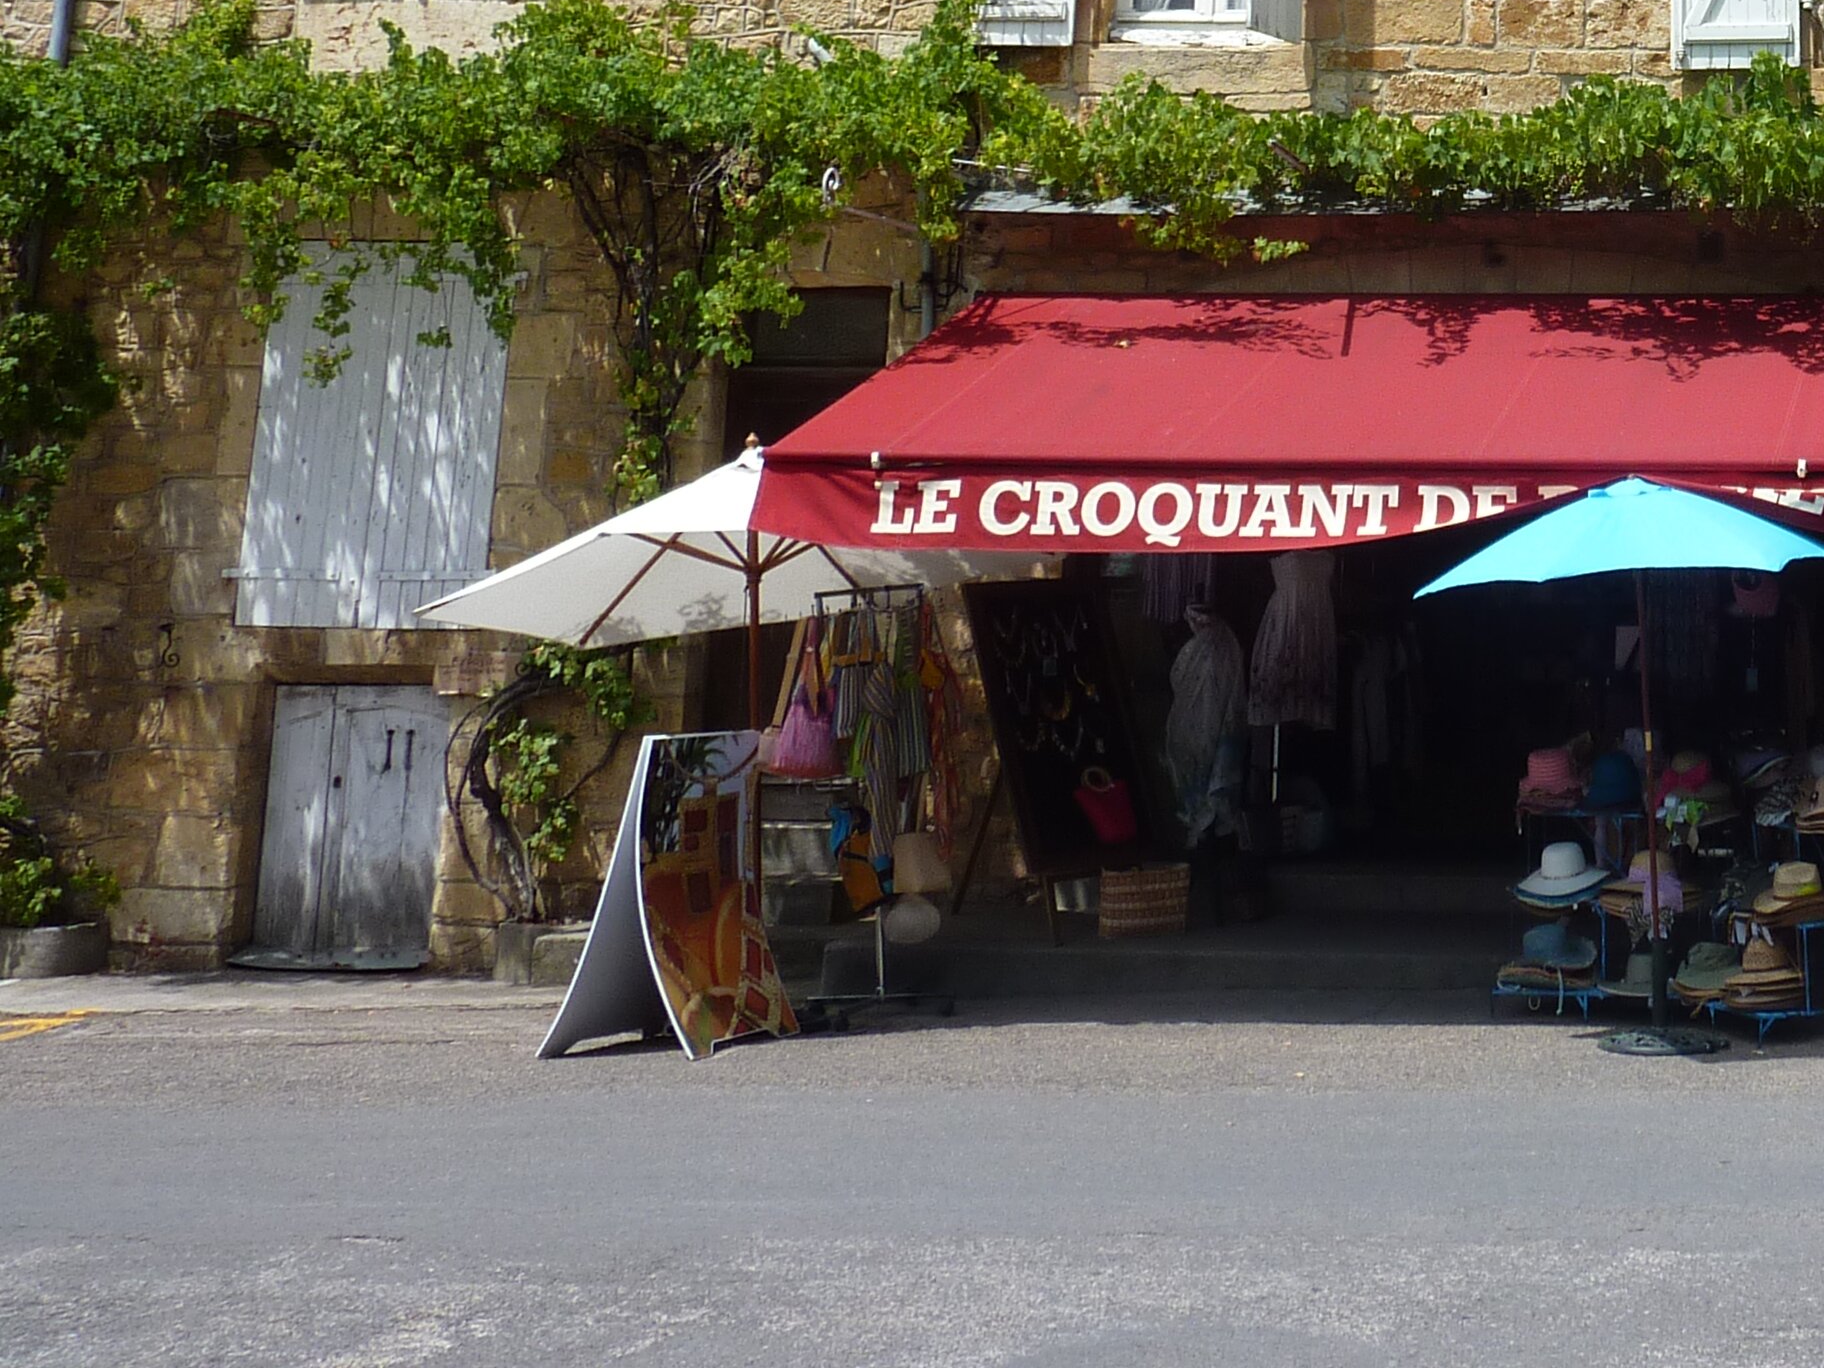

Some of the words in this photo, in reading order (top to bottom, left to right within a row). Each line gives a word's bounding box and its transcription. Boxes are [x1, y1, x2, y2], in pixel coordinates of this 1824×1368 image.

[869, 479, 962, 534] LE
[978, 480, 1400, 547] CROQUANT
[1412, 485, 1518, 533] DE
